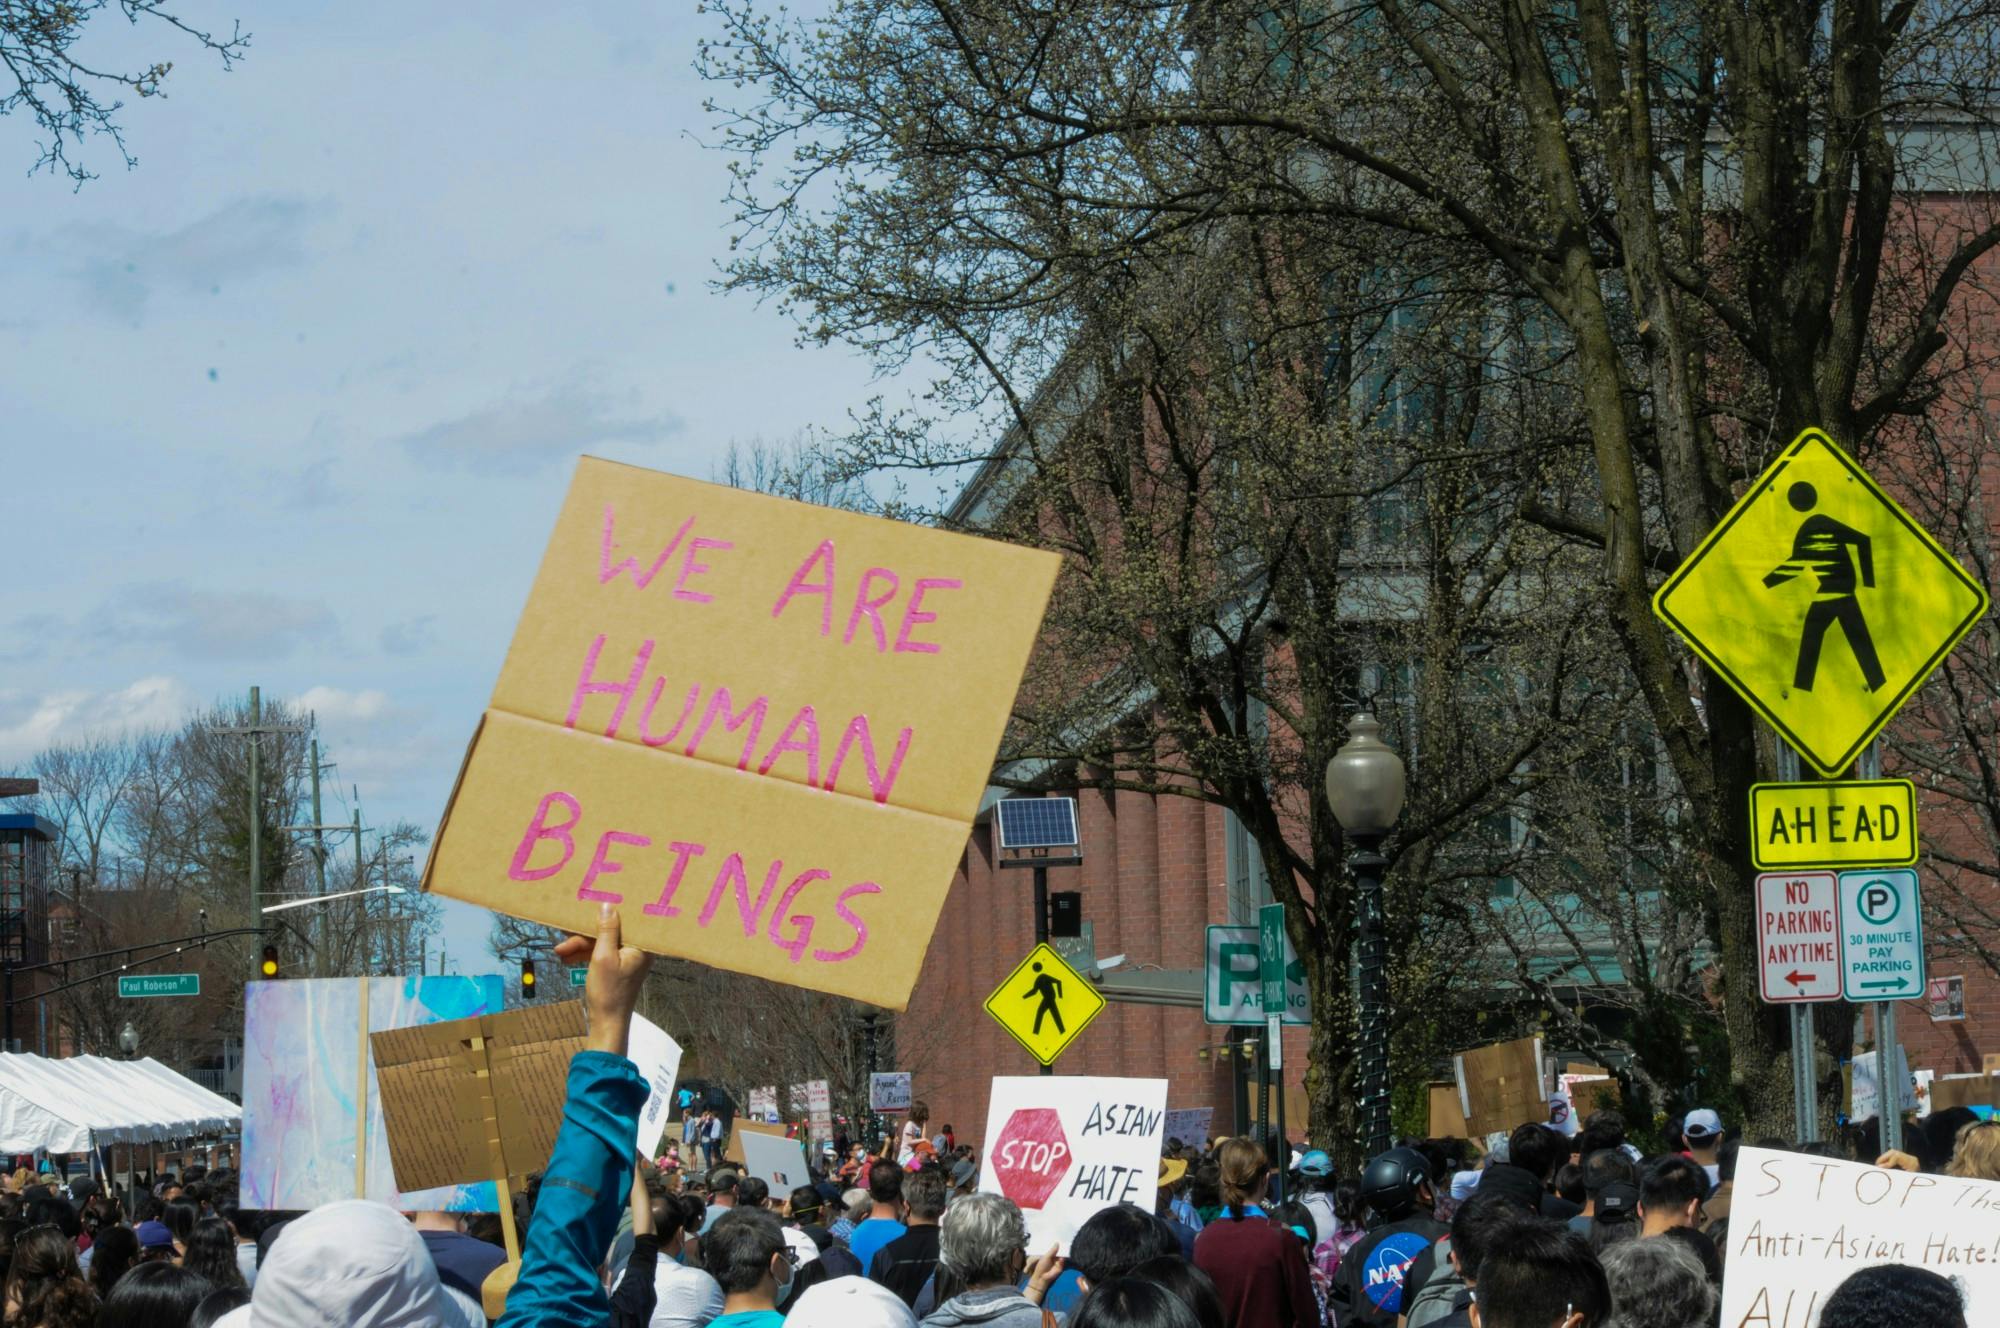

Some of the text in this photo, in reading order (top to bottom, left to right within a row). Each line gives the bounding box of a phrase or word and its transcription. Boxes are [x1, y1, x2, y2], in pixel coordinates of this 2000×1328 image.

[599, 502, 963, 653] WE ARE
[563, 632, 914, 806] HUMAN
[1769, 804, 1900, 844] AHEAD
[506, 791, 882, 963] BEINGS
[1785, 881, 1810, 905] NO
[1867, 888, 1889, 916] P
[1766, 909, 1833, 935] PARKING
[1850, 931, 1913, 945] 30 MINUTE
[1767, 942, 1835, 965] ANYTIME
[1852, 959, 1913, 974] PARKING
[1868, 946, 1893, 959] PAY
[123, 981, 140, 992] Paul
[143, 980, 178, 991] Robeson
[1081, 1101, 1162, 1137] ASIAN
[1001, 1138, 1067, 1176] STOP
[1068, 1164, 1143, 1205] HATE
[1756, 1159, 1937, 1208] STOP
[1739, 1219, 1906, 1260] Anti-Asian
